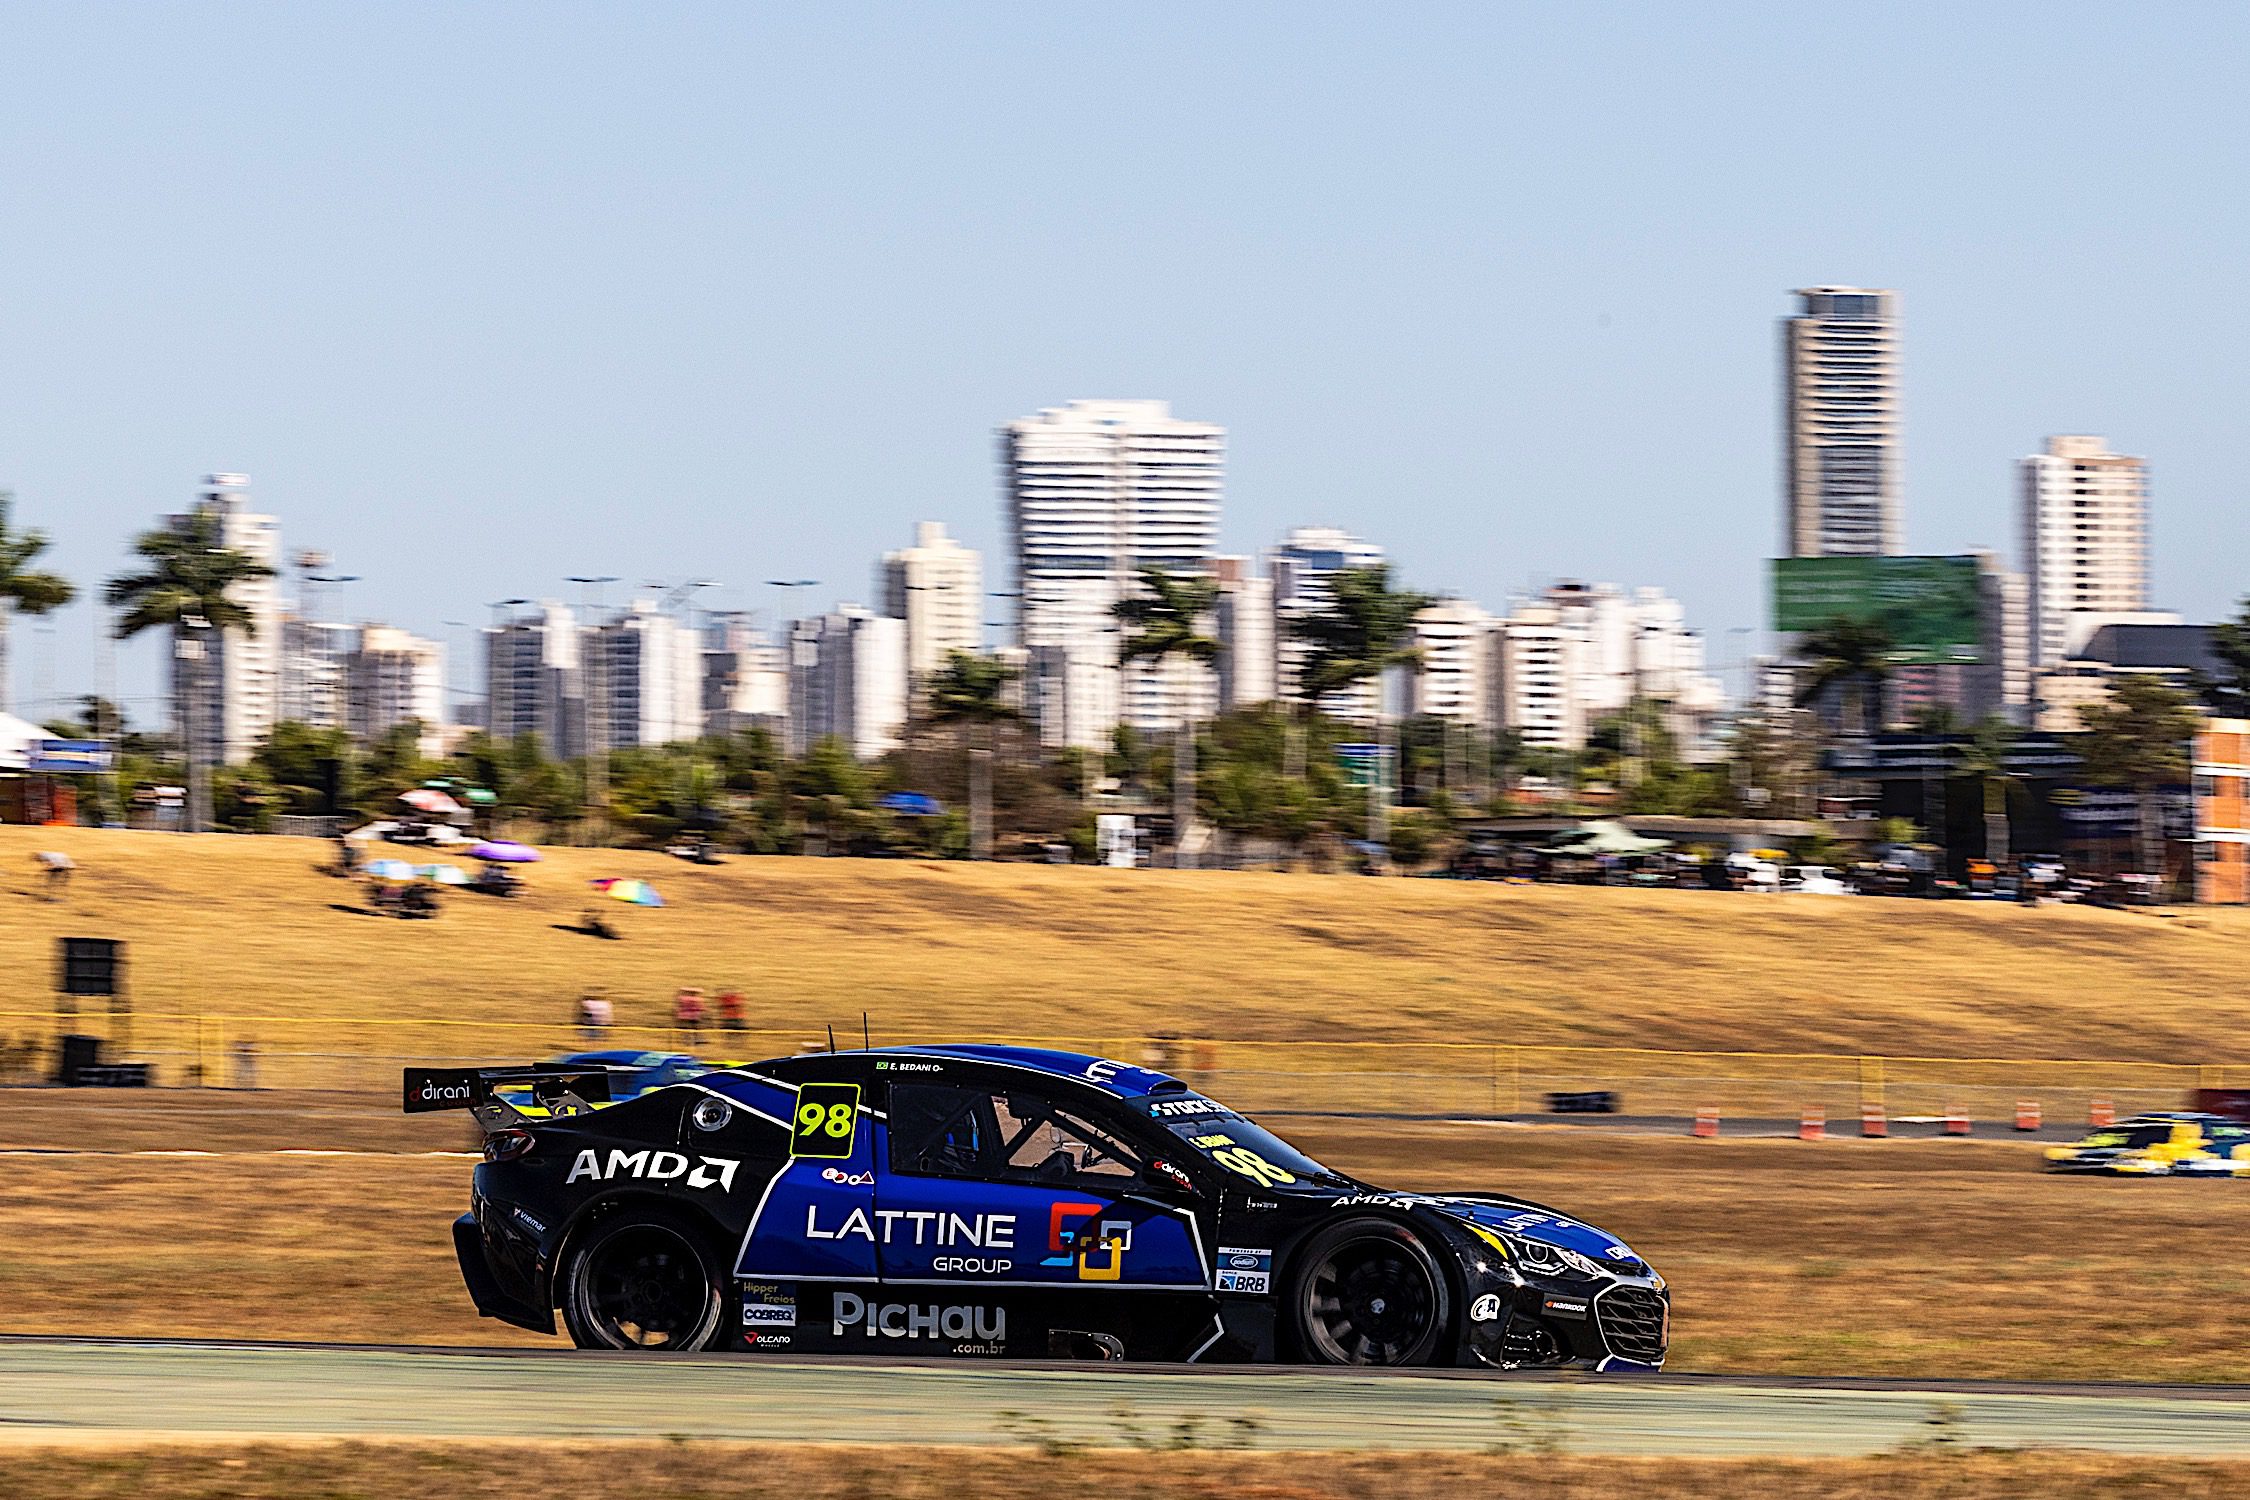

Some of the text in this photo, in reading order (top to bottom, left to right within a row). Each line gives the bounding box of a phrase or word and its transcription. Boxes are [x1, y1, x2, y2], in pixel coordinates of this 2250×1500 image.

[798, 1103, 852, 1138] 98
[566, 1149, 689, 1185] AMD
[1212, 1147, 1296, 1188] 98
[1331, 1195, 1391, 1208] AMD
[806, 1205, 1016, 1248] LATTINE
[932, 1256, 1012, 1274] GROUP
[743, 1281, 779, 1295] Hipper
[1235, 1275, 1266, 1292] BRB
[763, 1293, 796, 1304] Freios
[952, 1341, 1006, 1354] .com.br
